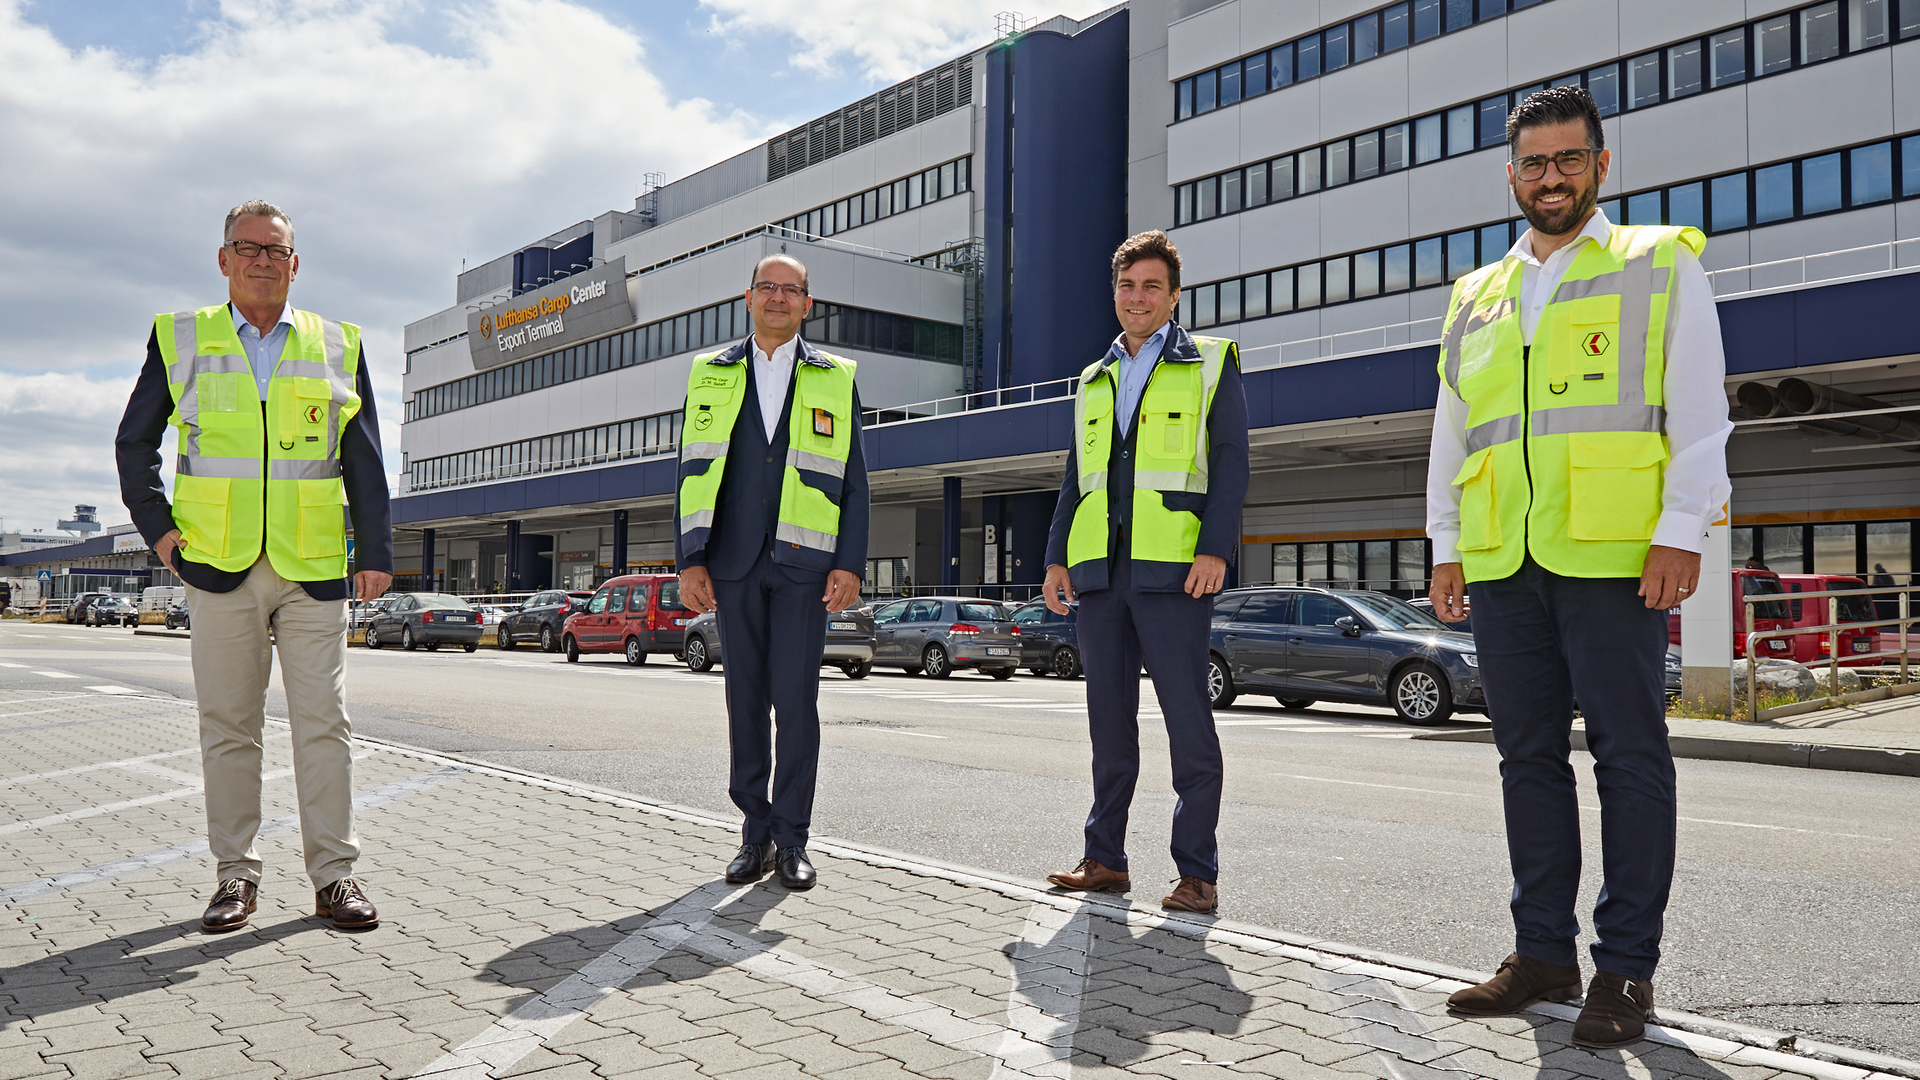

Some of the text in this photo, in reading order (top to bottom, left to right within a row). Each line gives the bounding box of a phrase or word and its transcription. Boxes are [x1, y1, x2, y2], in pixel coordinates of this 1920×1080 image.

[495, 280, 607, 331] Lufthansa Cargo Center
[497, 315, 564, 352] Export Terminal
[985, 525, 996, 543] B
